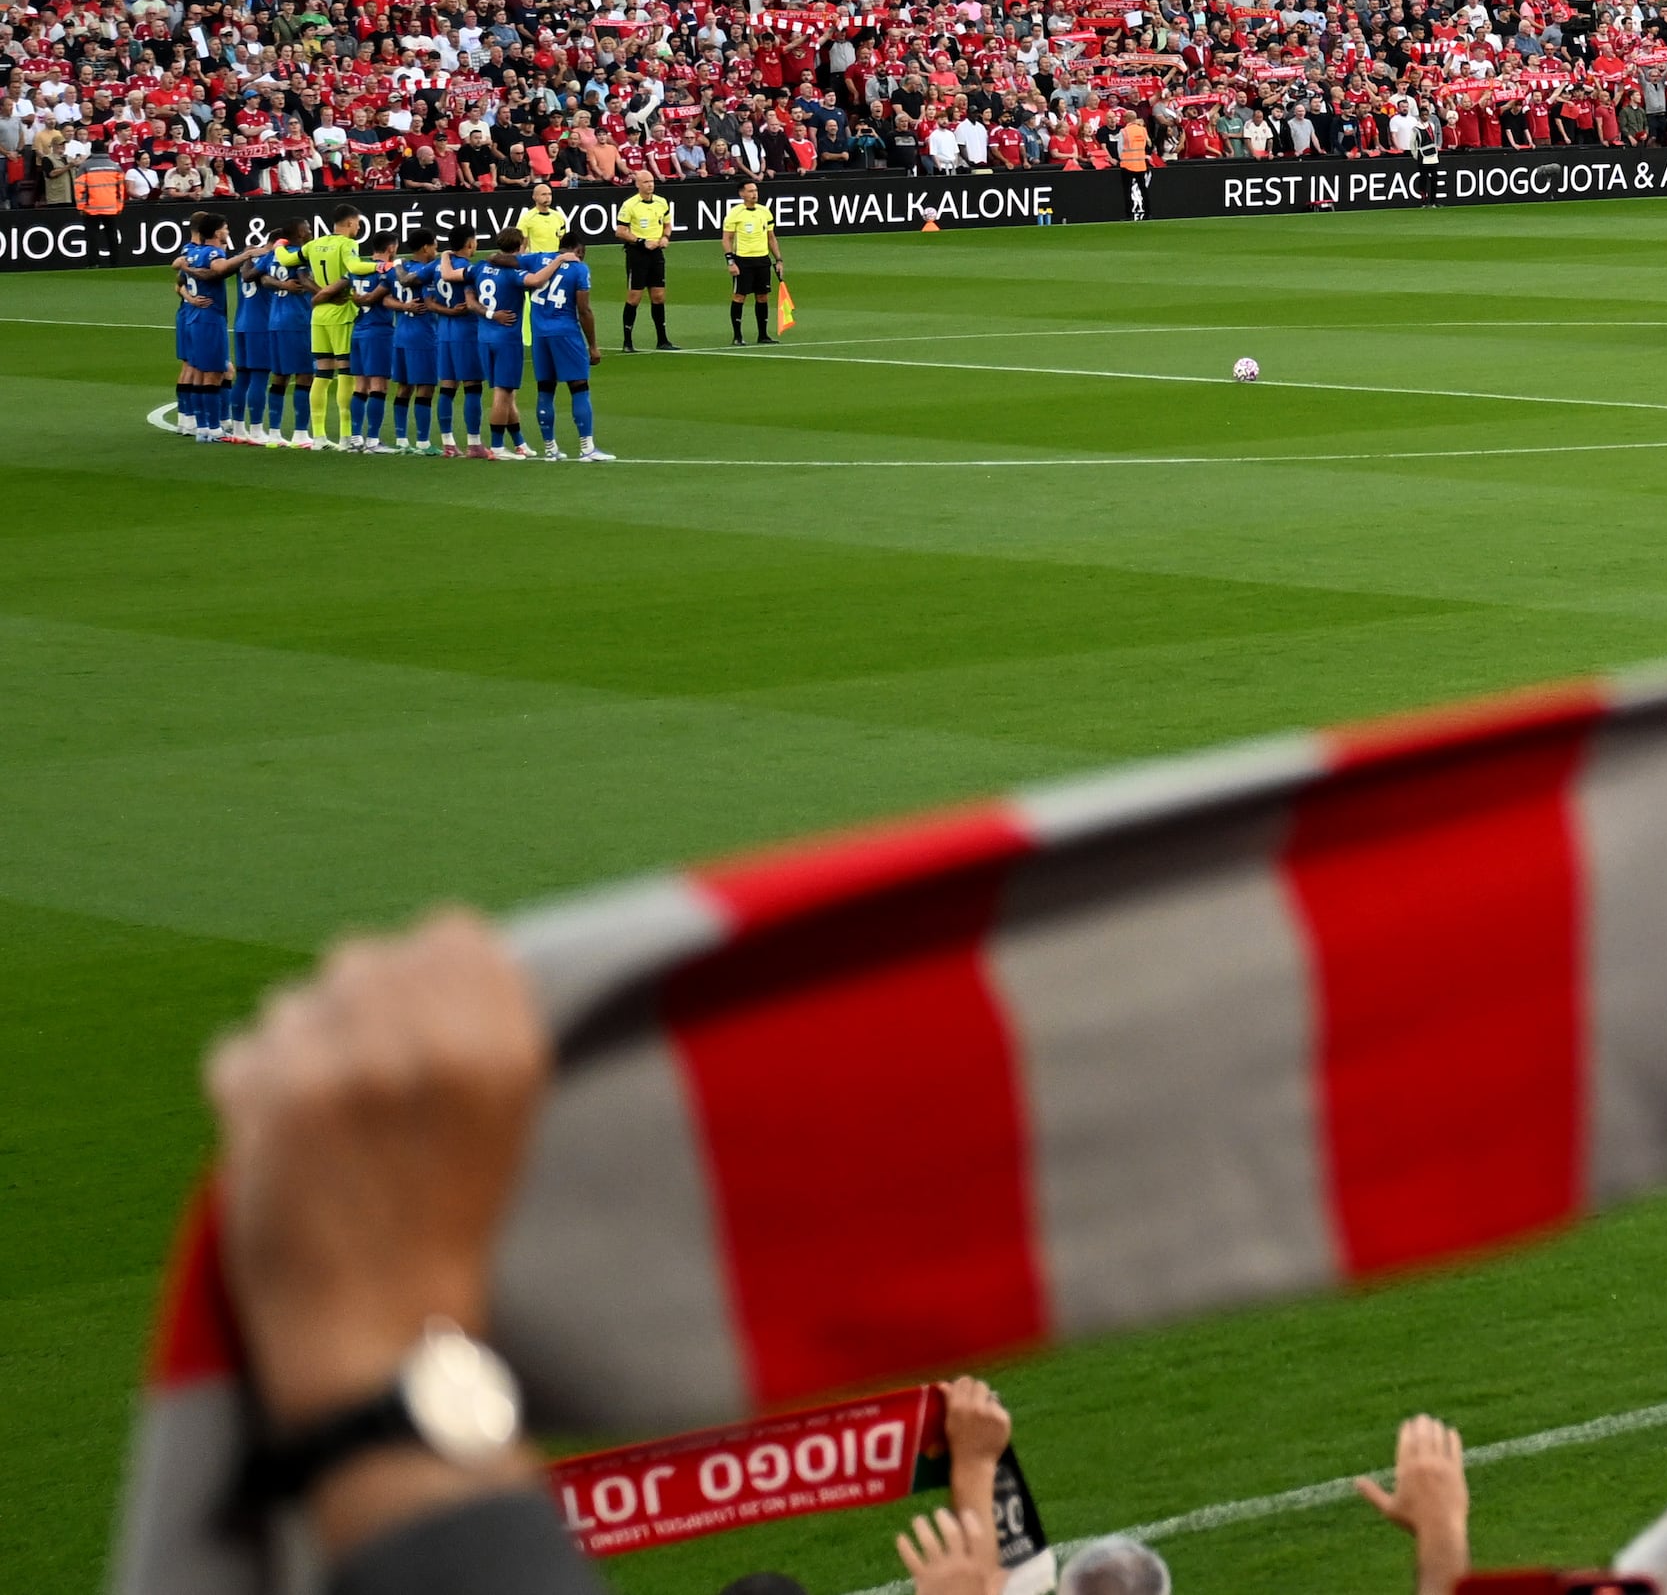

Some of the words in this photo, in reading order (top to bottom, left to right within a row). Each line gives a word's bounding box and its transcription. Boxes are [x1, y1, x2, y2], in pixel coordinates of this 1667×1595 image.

[1224, 176, 1303, 208] REST
[1308, 173, 1342, 205] IN
[1455, 168, 1552, 198] DIOGO
[1554, 163, 1628, 193] JOTA
[1633, 161, 1655, 189] &
[245, 216, 275, 247] &
[829, 188, 926, 224] WALK
[936, 186, 1053, 222] ALONE
[318, 261, 329, 285] 1
[478, 279, 497, 312] 8
[530, 276, 566, 309] 24
[699, 1419, 908, 1504] DIOGO
[562, 1466, 677, 1531] JOT
